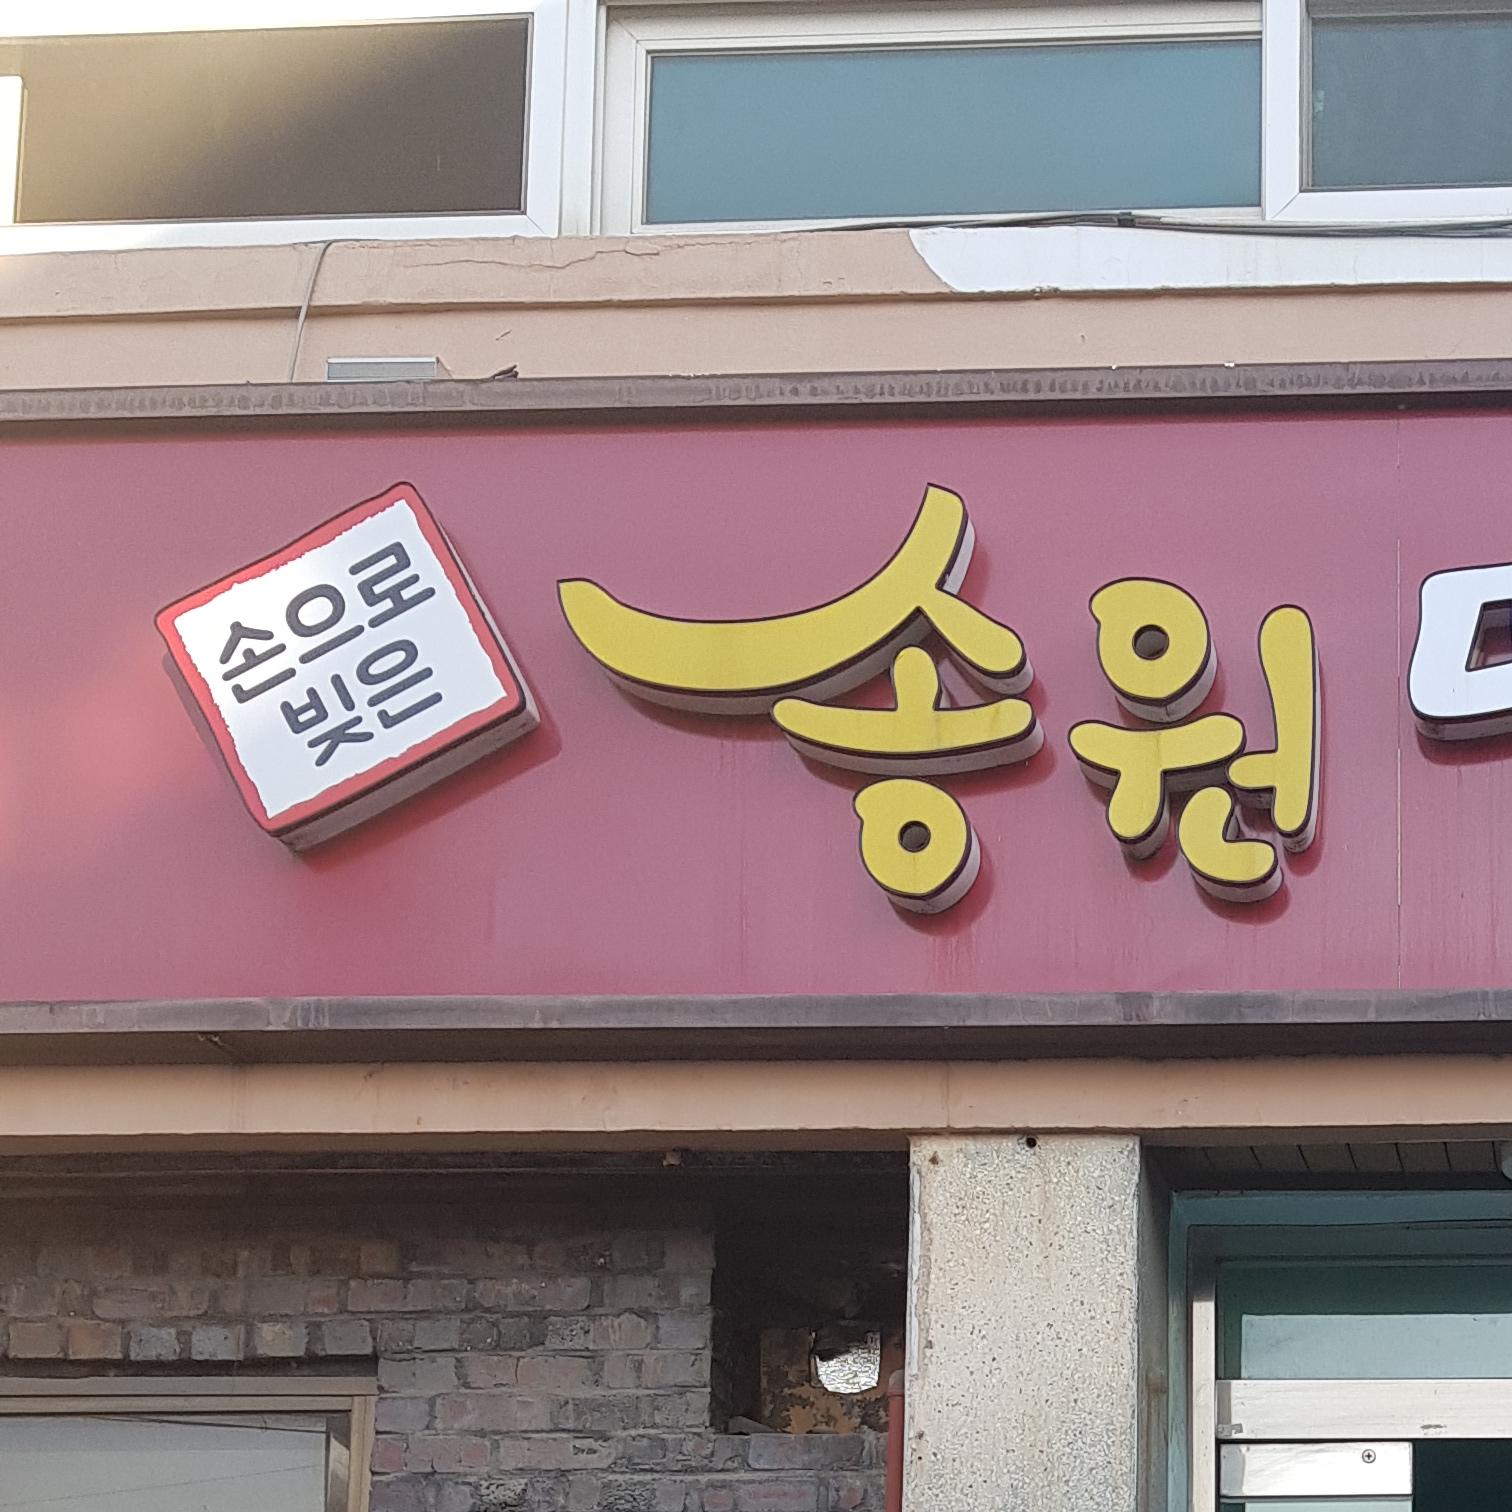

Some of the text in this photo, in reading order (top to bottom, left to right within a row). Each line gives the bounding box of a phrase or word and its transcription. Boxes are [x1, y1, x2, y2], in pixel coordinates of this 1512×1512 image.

[219, 541, 436, 704] 손으로
[280, 639, 443, 767] 빚은
[557, 482, 1319, 906] 송원
